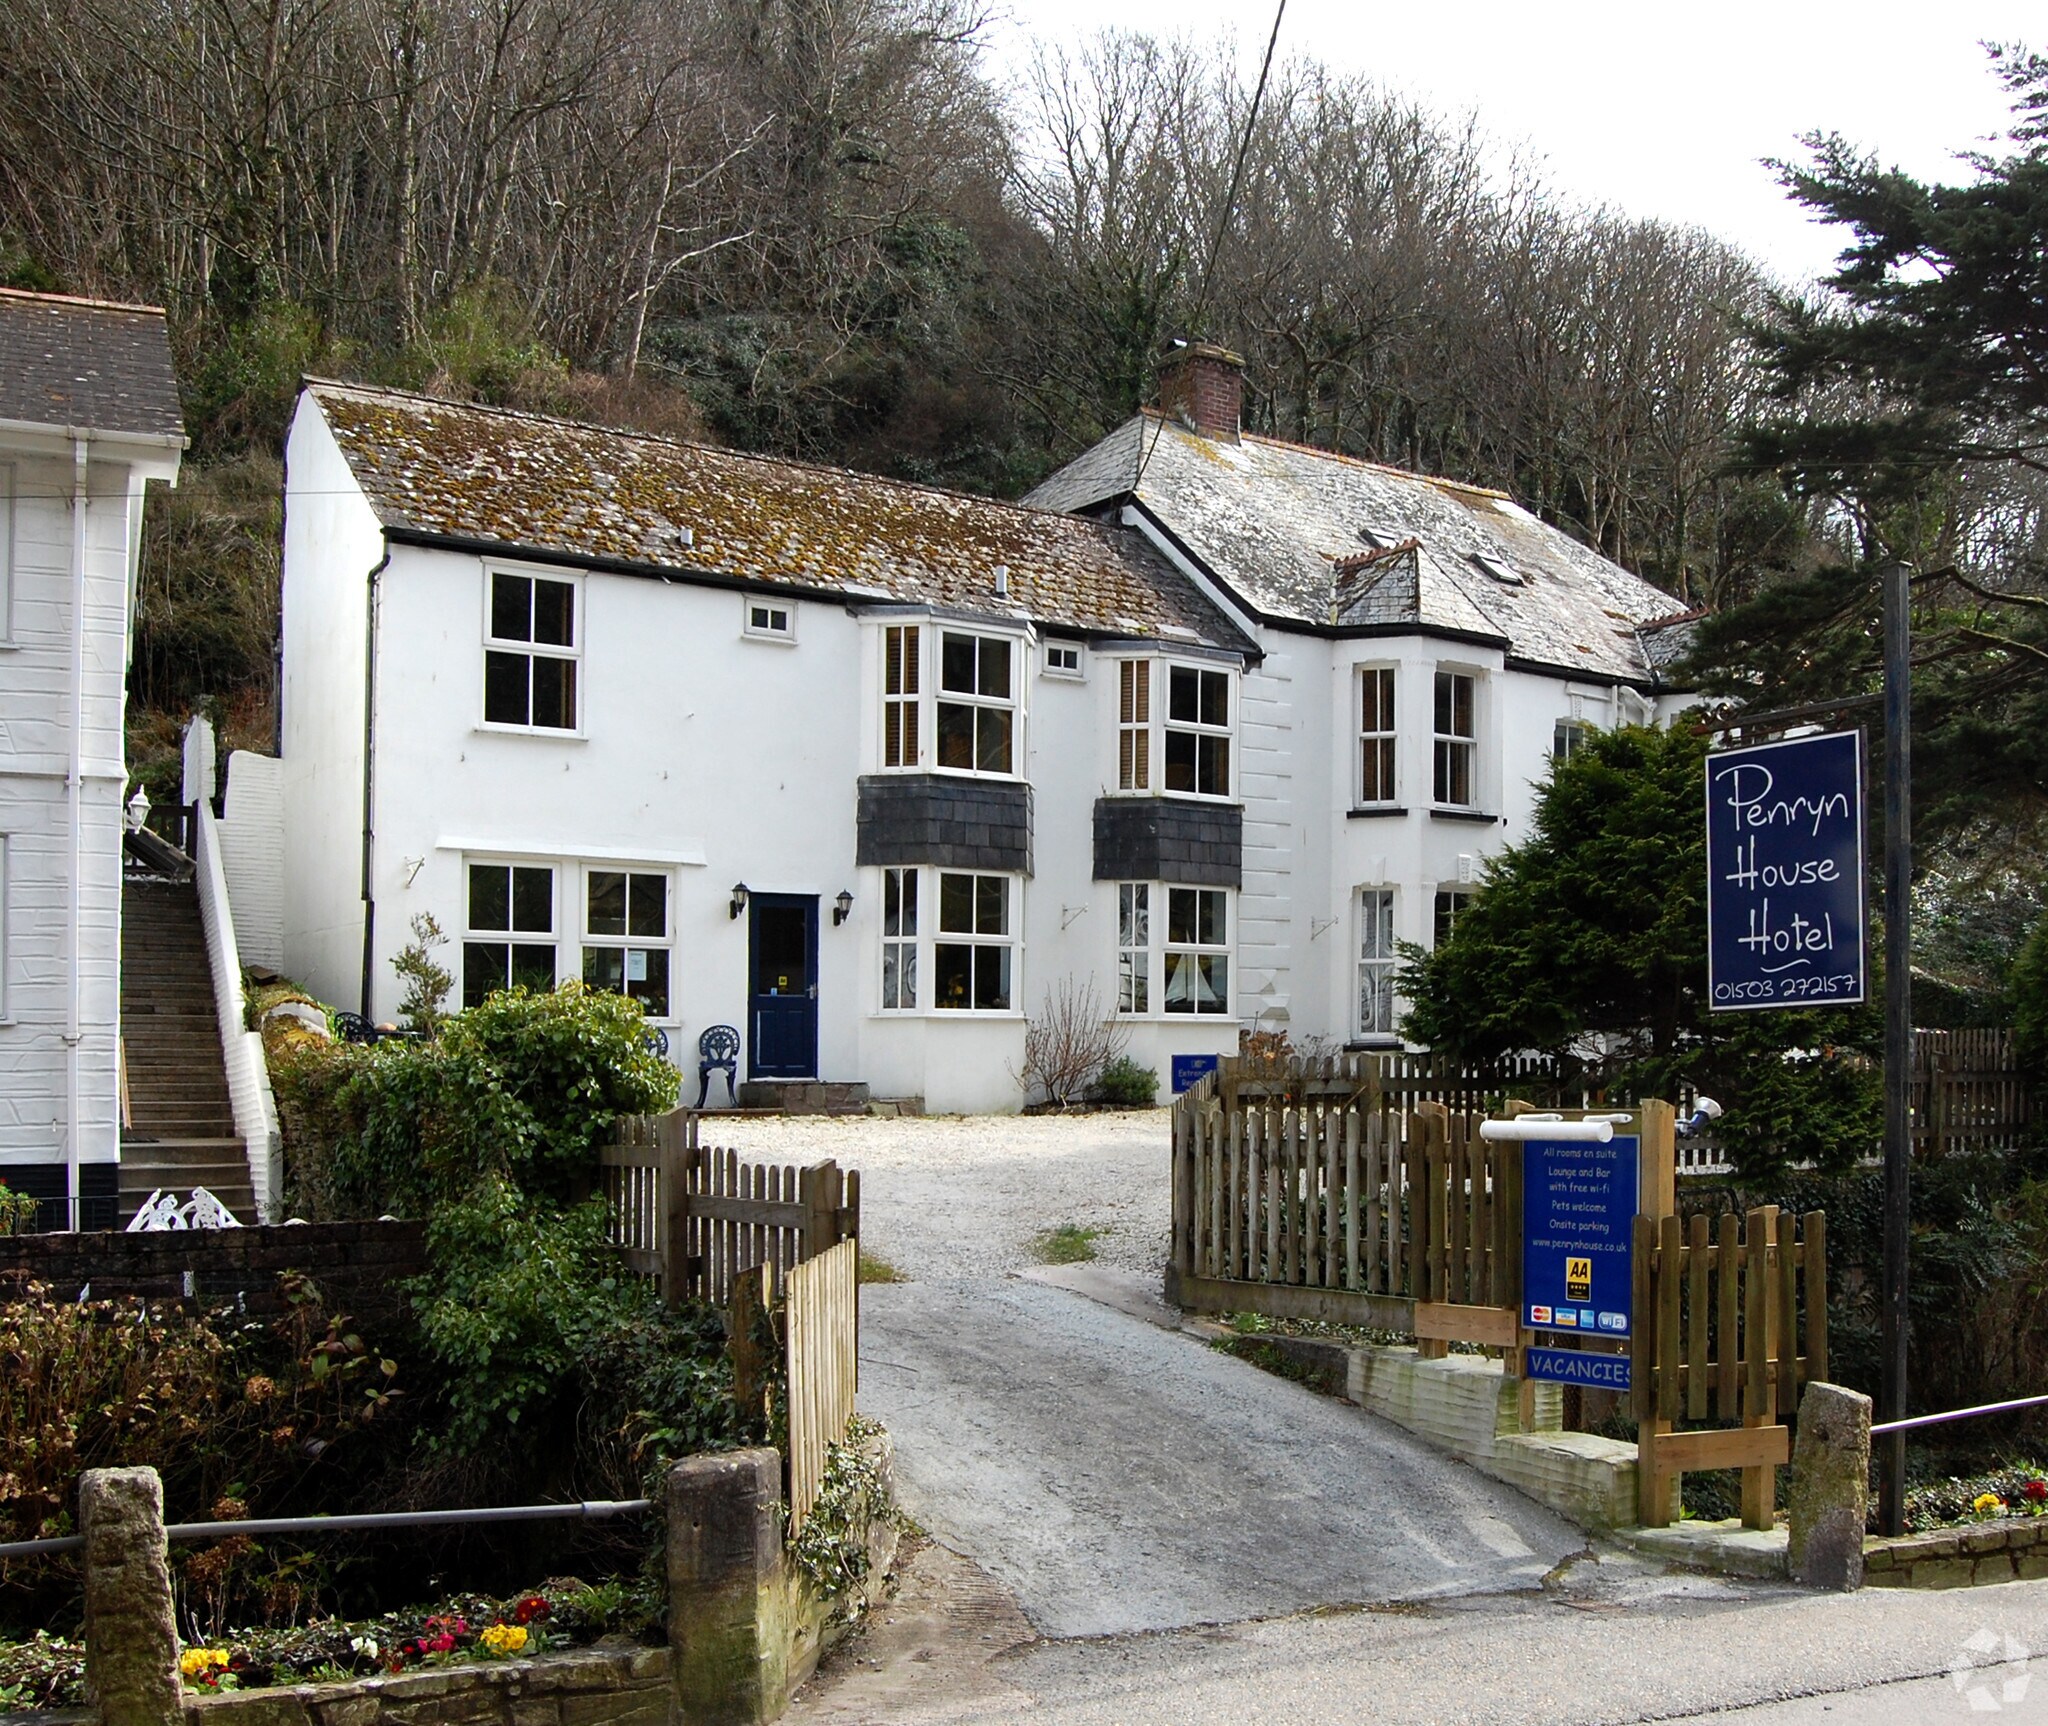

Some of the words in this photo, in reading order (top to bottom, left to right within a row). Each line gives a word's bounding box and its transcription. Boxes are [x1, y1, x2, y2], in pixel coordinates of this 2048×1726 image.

[1715, 763, 1849, 836] Penryn
[1726, 834, 1840, 891] House
[1738, 897, 1833, 955] Hotel
[1714, 979, 1774, 1000] 01503
[1780, 974, 1857, 997] 272157
[1543, 1147, 1555, 1157] All
[1556, 1149, 1581, 1158] rooms
[1583, 1150, 1594, 1158] en
[1595, 1148, 1617, 1159] suite
[1548, 1166, 1577, 1180] Lounge
[1578, 1167, 1593, 1177] and
[1595, 1167, 1611, 1178] Bar
[1549, 1181, 1567, 1192] with
[1569, 1181, 1588, 1193] free
[1590, 1183, 1610, 1194] wi-fi
[1552, 1200, 1570, 1211] Pets
[1572, 1202, 1607, 1213] welcome
[1549, 1218, 1577, 1230] Onsite
[1578, 1220, 1610, 1235] parking
[1532, 1239, 1627, 1253] www.penrynhouse.co.uk
[1570, 1261, 1588, 1279] AA
